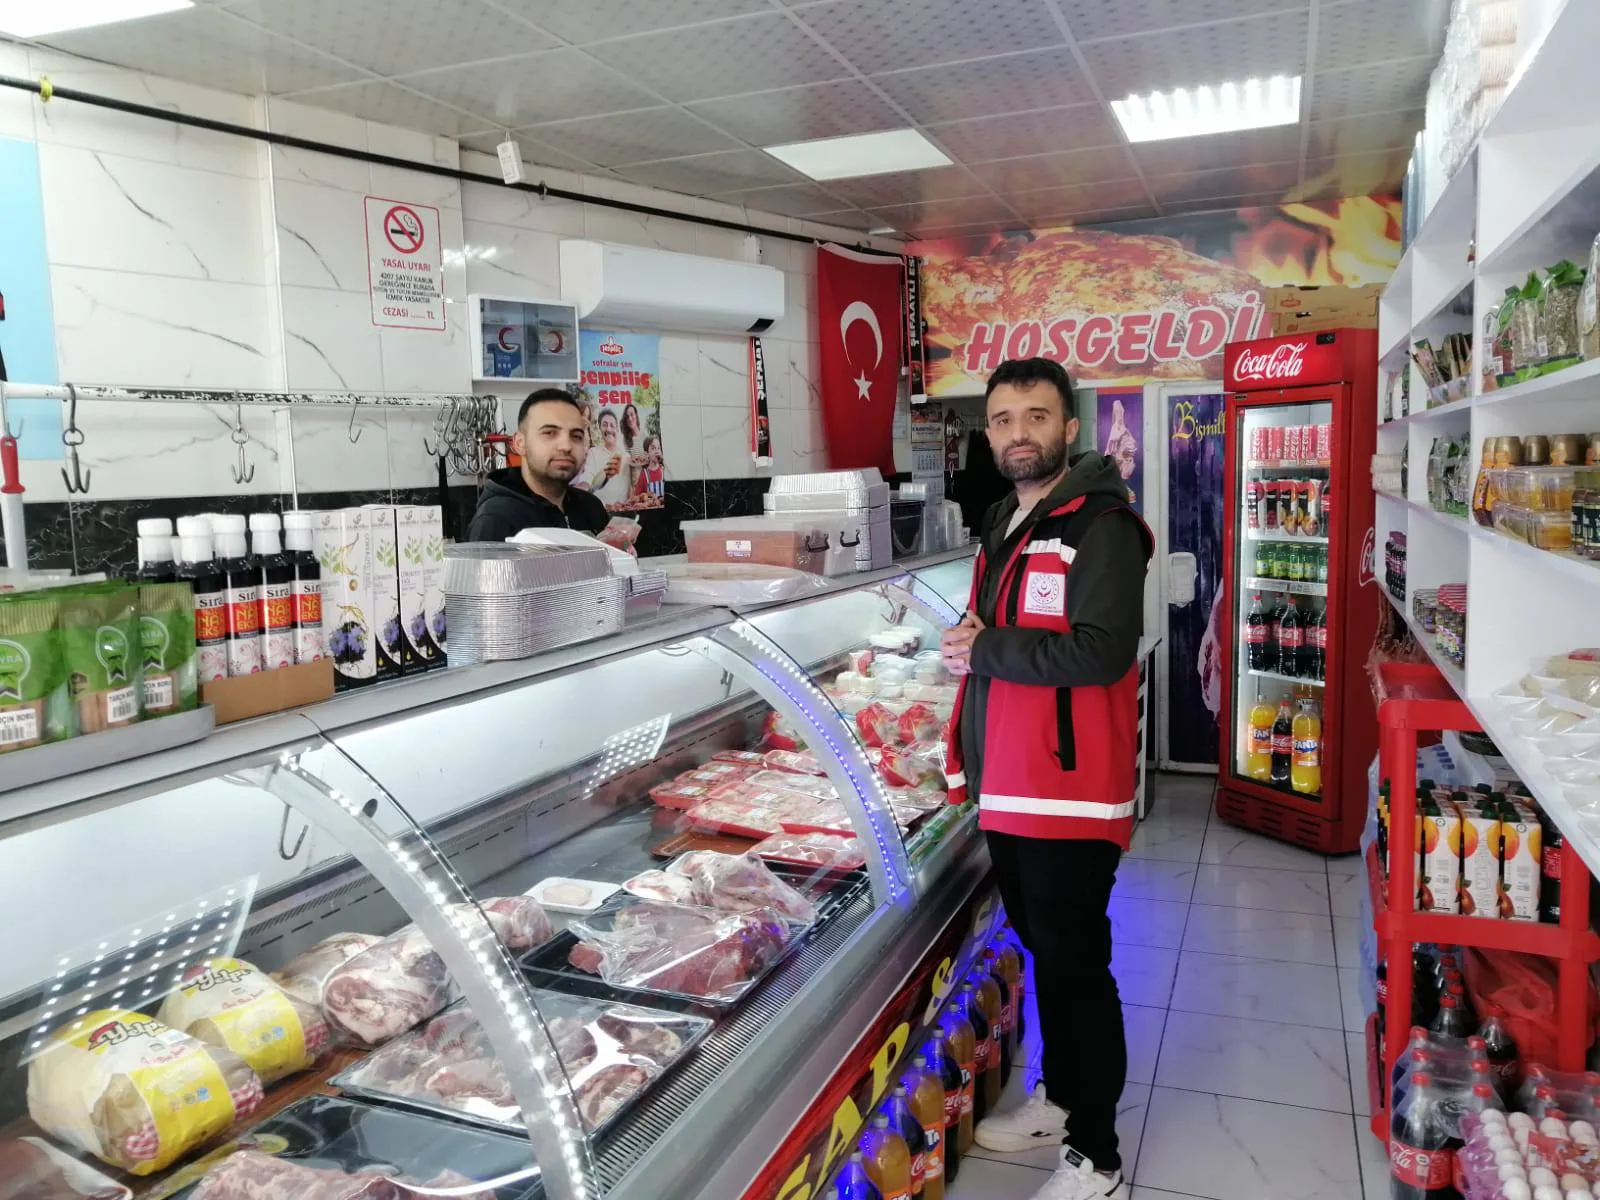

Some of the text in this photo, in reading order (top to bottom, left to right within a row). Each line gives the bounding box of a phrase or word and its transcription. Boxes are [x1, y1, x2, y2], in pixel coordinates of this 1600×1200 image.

[382, 258, 431, 272] YASAL UYARI
[427, 310, 435, 319] TL
[1234, 343, 1308, 382] Coca-Cola
[598, 390, 632, 407] şen
